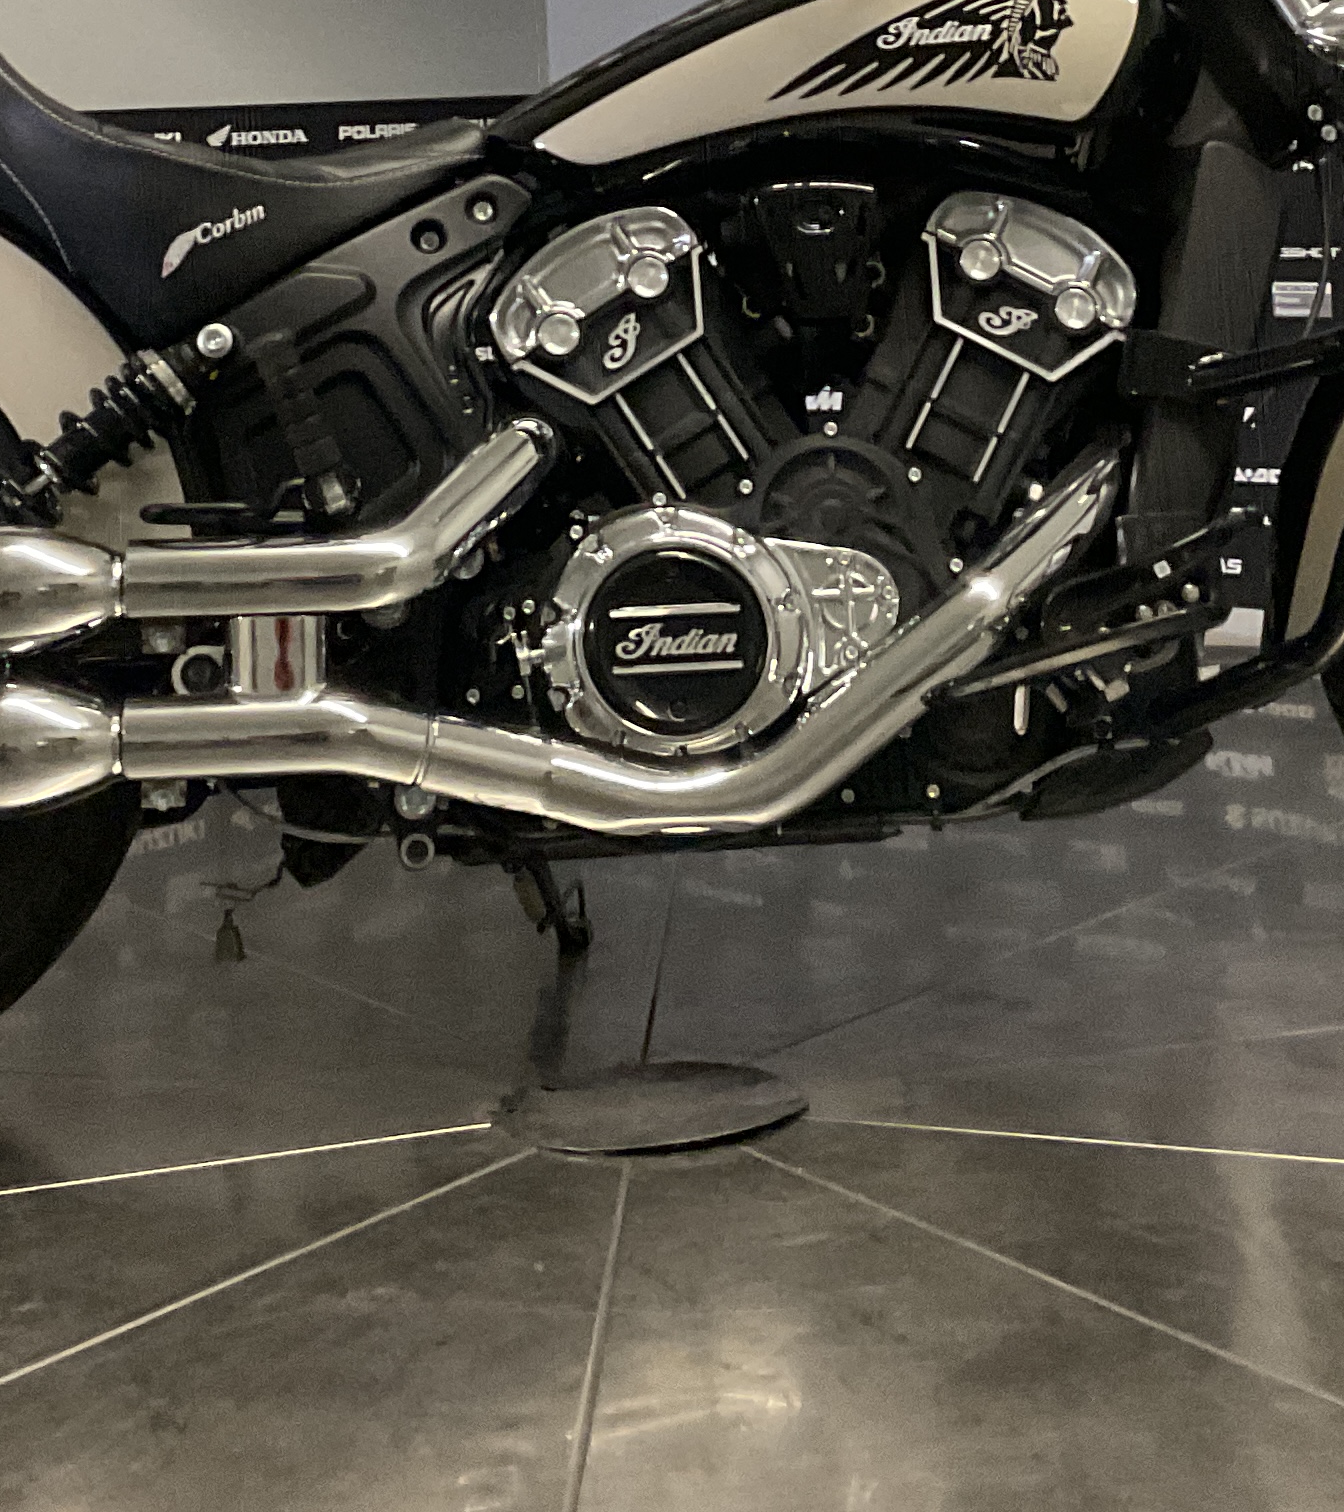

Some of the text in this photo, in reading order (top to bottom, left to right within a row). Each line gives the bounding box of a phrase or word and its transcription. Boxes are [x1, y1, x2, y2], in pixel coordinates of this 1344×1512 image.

[876, 16, 993, 50] Indian
[230, 128, 308, 146] HONDA
[196, 204, 265, 243] Corbin
[616, 623, 738, 660] Indian
